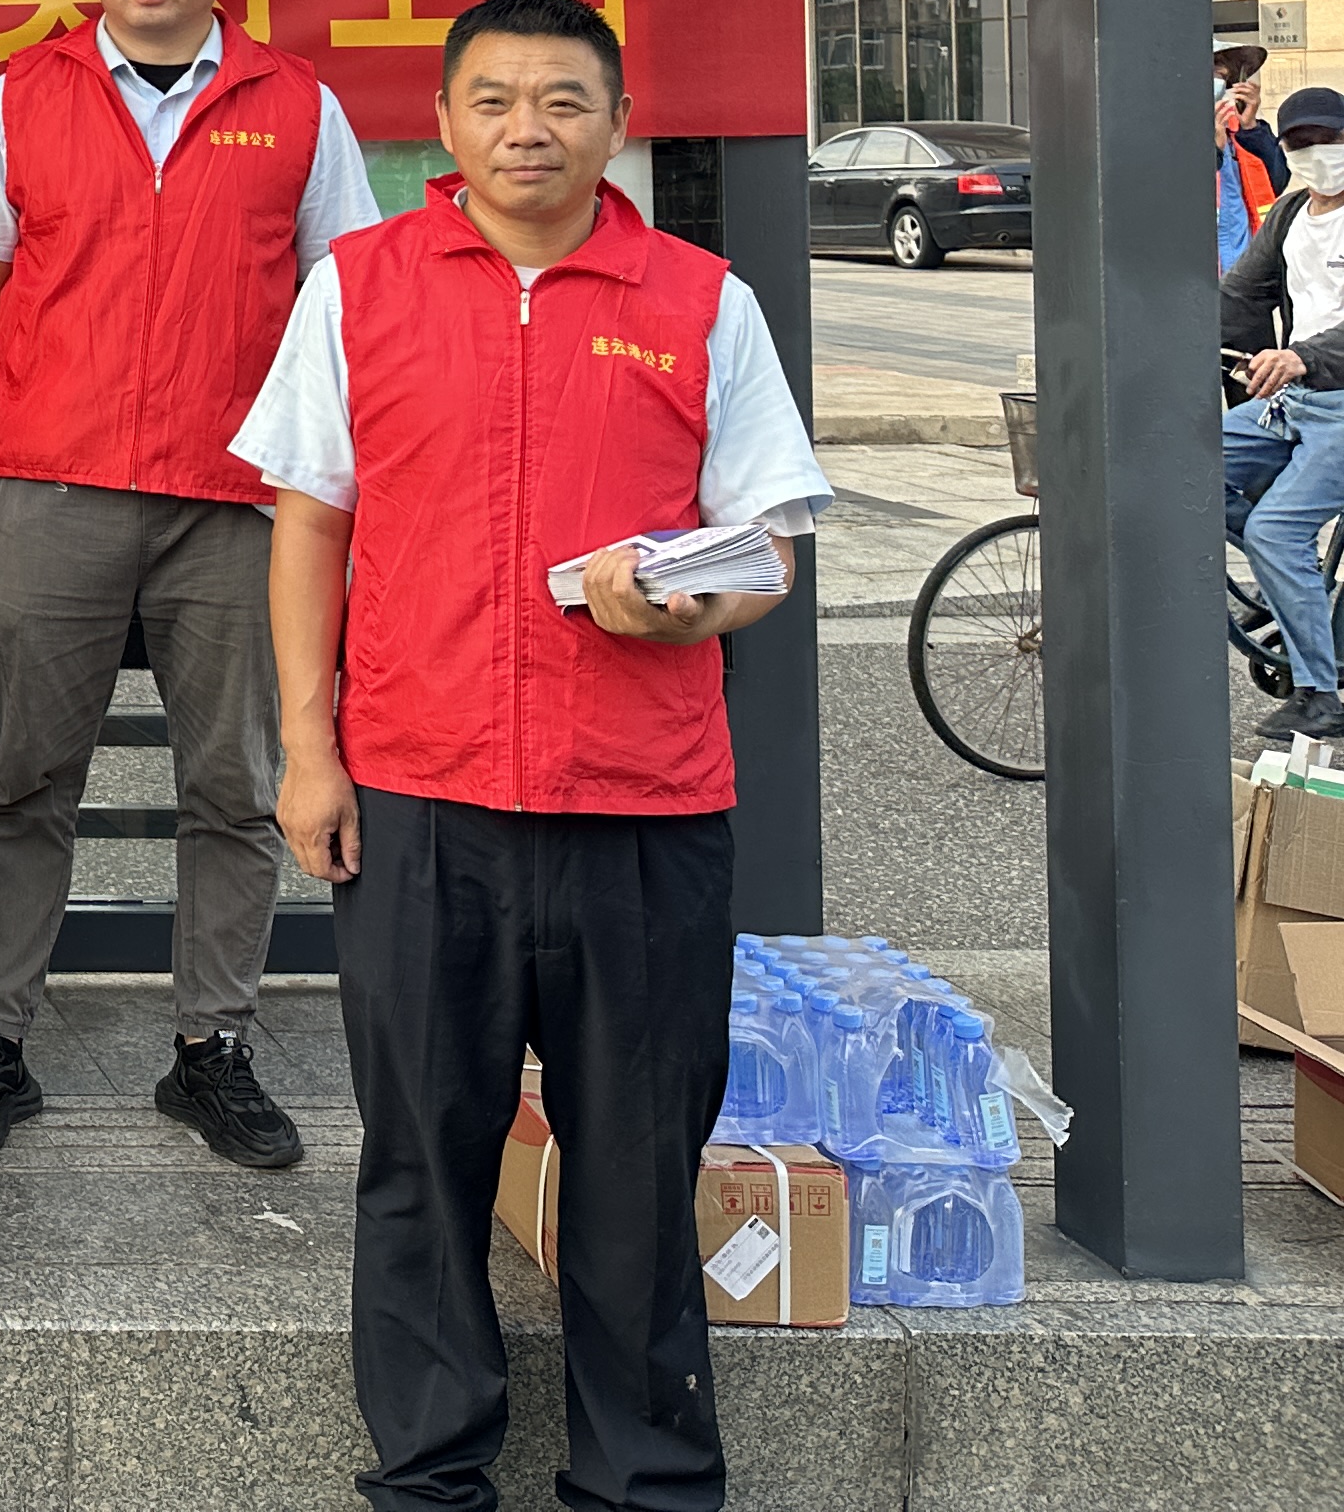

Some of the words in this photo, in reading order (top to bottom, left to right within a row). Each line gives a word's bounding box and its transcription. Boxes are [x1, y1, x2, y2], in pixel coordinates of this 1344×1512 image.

[210, 128, 276, 149] 连云港公交
[591, 336, 677, 374] 连云港公交
